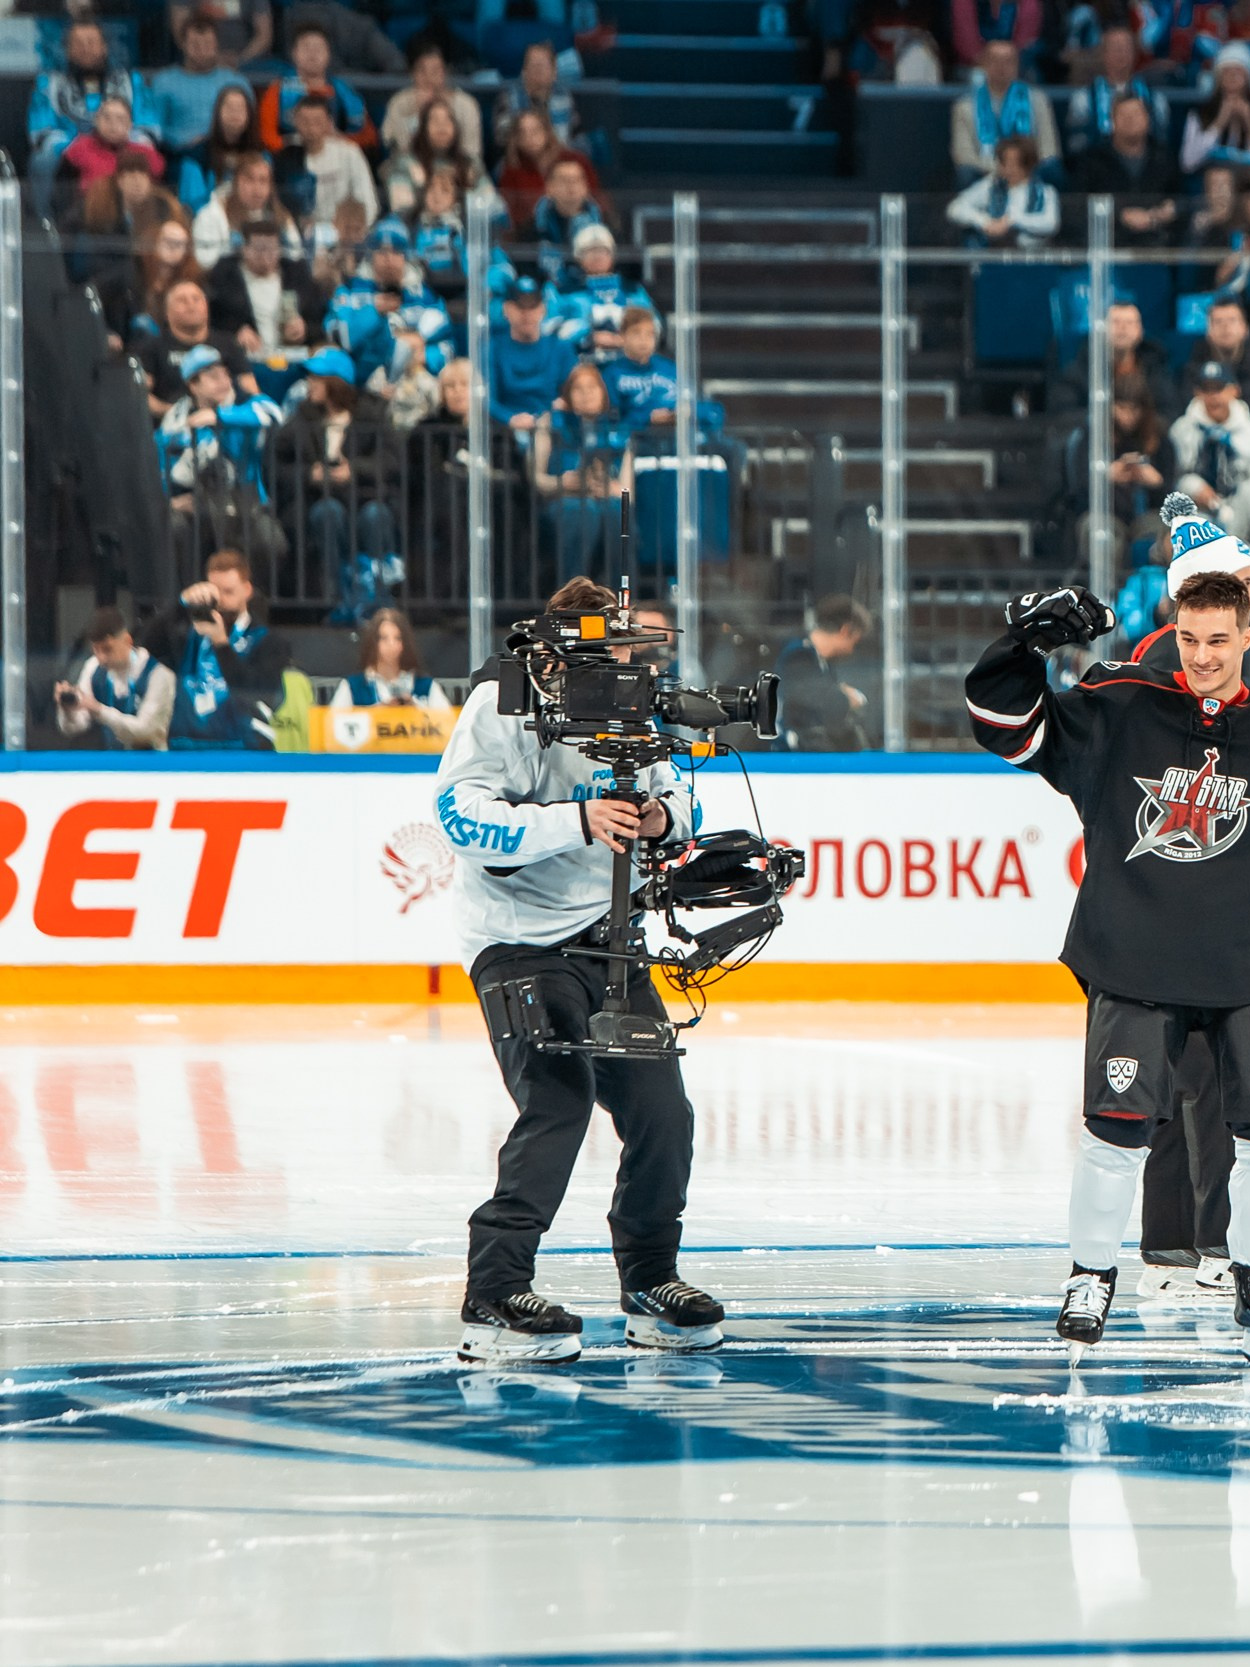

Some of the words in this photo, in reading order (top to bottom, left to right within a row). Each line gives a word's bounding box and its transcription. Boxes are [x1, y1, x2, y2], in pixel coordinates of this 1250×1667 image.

[1159, 769, 1197, 804] ALL
[1194, 775, 1245, 812] STAR
[0, 799, 288, 938] ET
[1183, 851, 1203, 859] 2012
